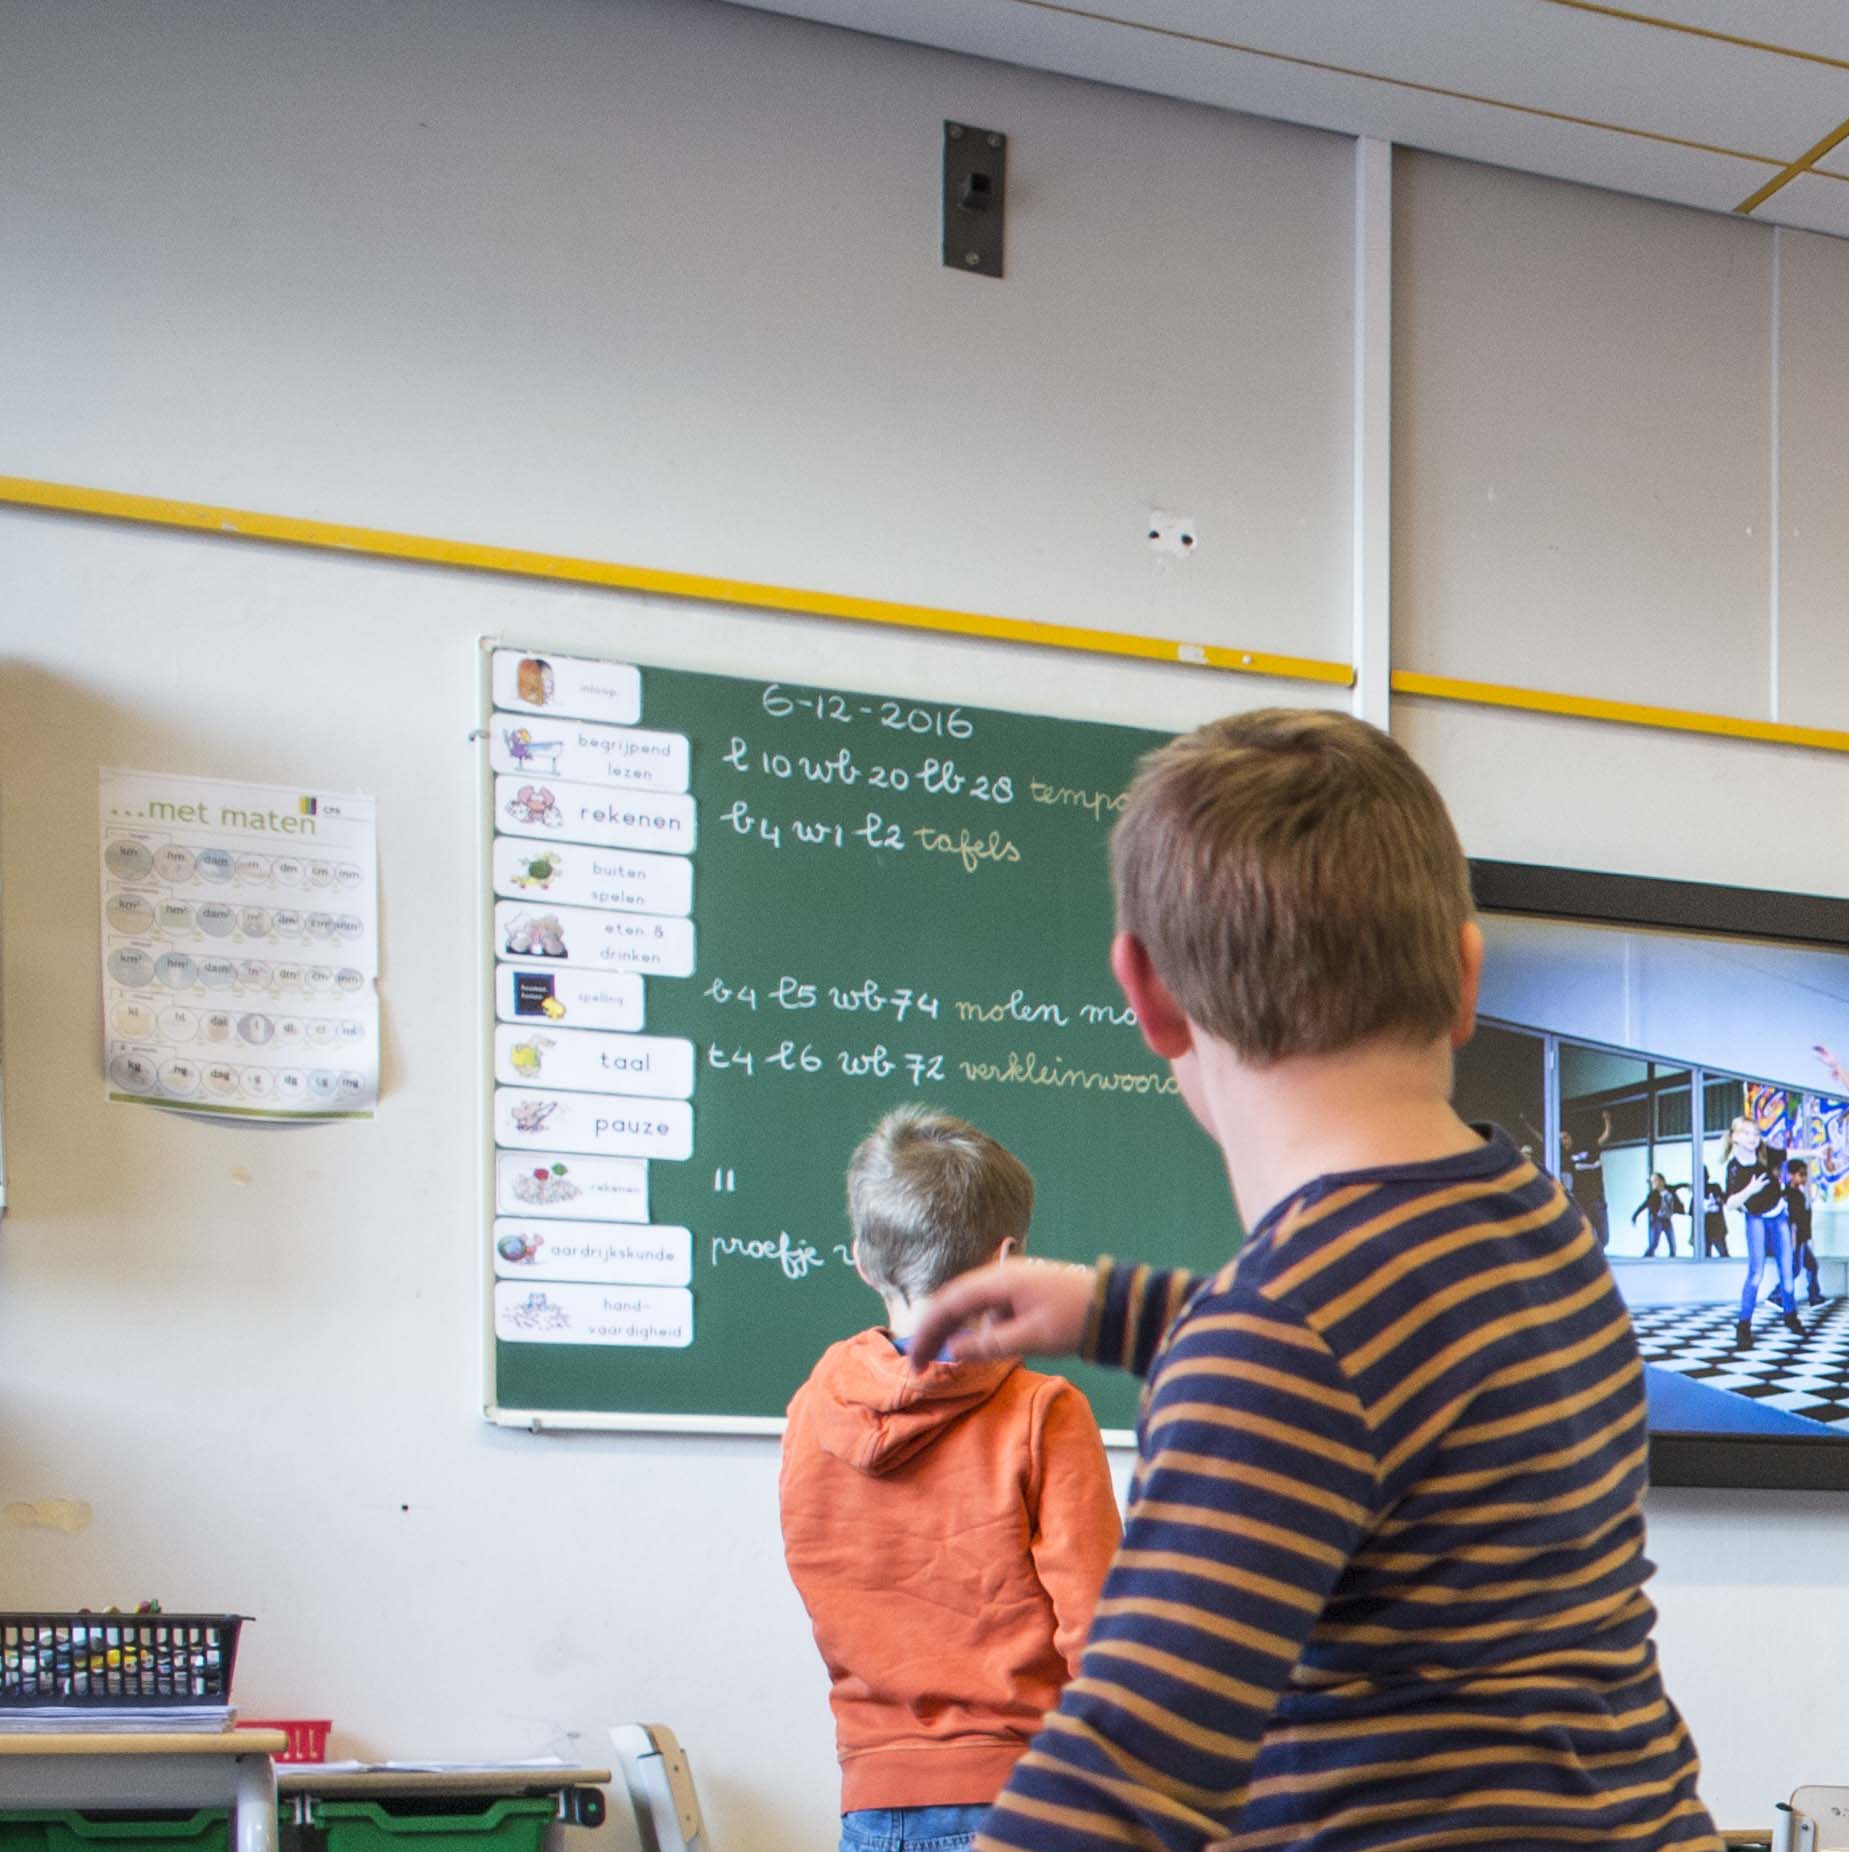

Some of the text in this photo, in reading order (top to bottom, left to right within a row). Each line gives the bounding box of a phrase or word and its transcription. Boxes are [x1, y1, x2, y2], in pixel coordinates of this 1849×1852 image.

[762, 684, 973, 739] 6-12-2016
[577, 733, 672, 757] begrijpend
[607, 761, 653, 780] lezen
[867, 766, 910, 792] 20
[220, 807, 318, 836] maten
[580, 804, 682, 832] rekenen
[913, 825, 1021, 873] tafels
[592, 860, 647, 880] buiten
[592, 890, 645, 906] spelen
[604, 924, 644, 937] eten
[599, 948, 662, 965] drinken
[955, 988, 1068, 1027] molen
[600, 1052, 651, 1072] taal
[905, 1053, 946, 1087] 72
[594, 1118, 670, 1138] pauze
[551, 1243, 675, 1263] aardrijkskunde
[588, 1325, 684, 1342] vaardigheid
